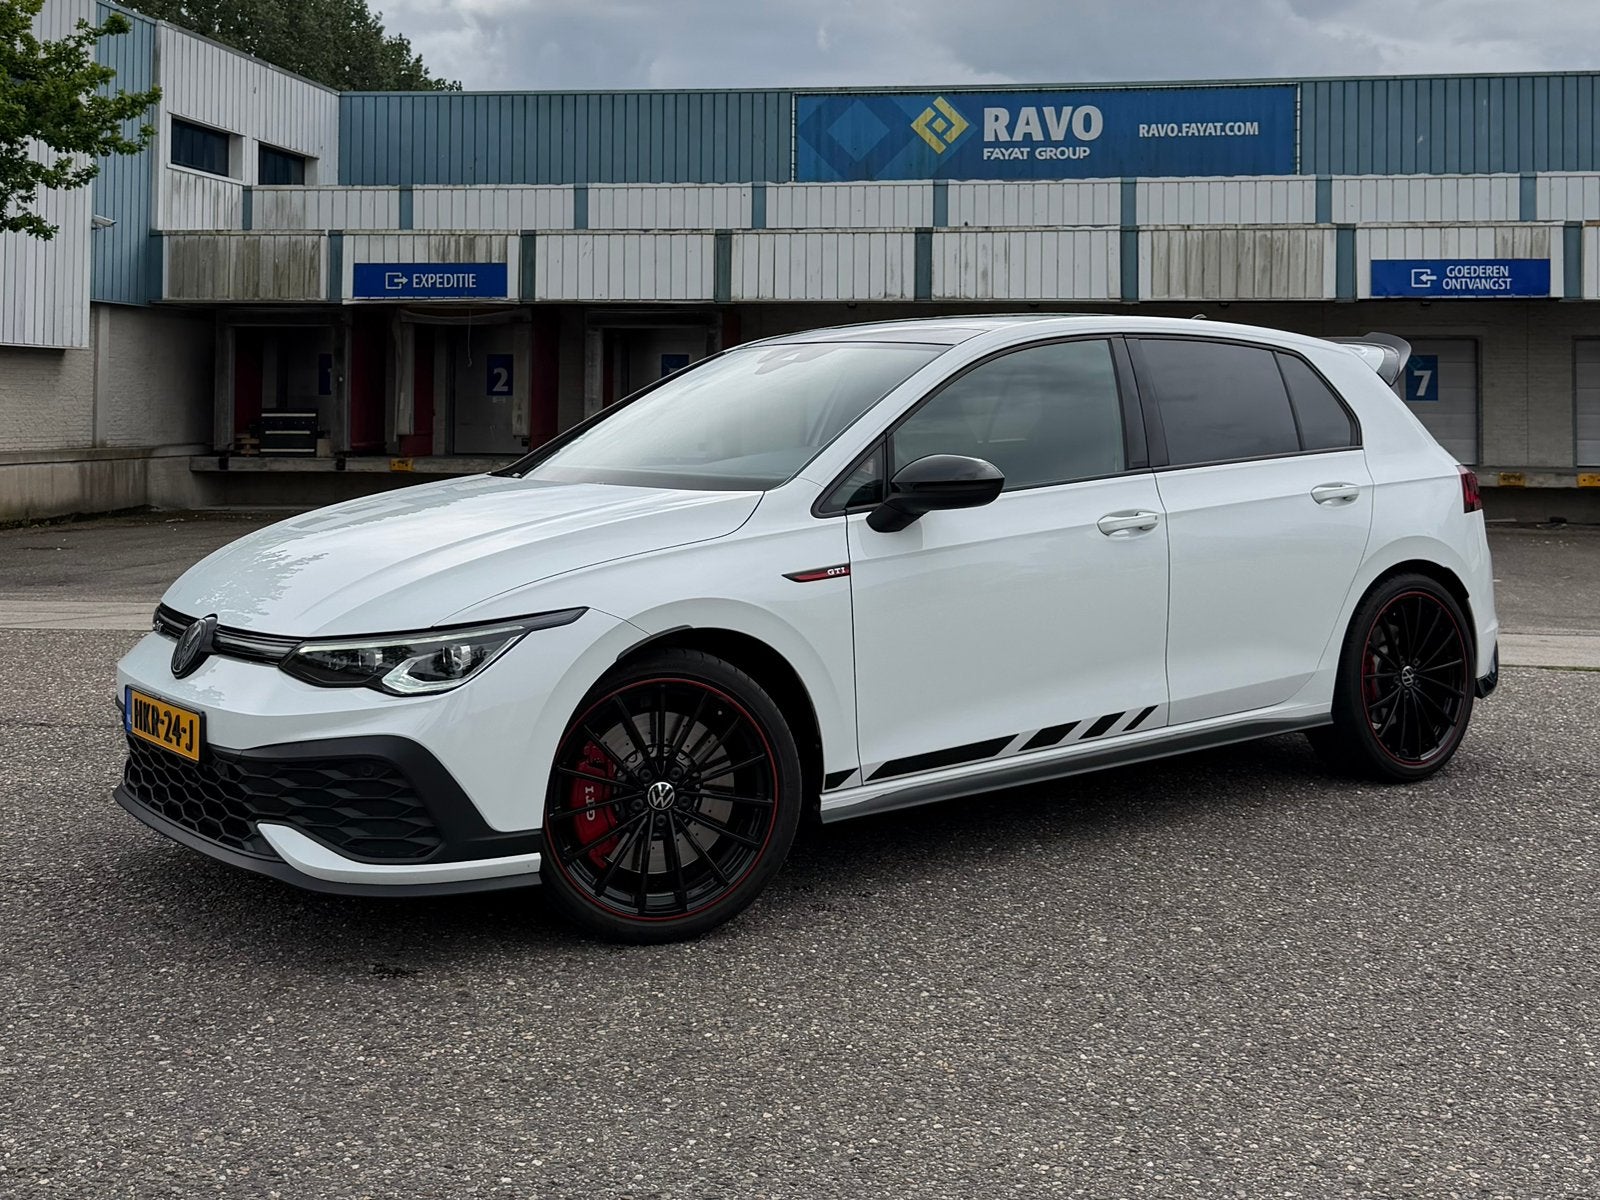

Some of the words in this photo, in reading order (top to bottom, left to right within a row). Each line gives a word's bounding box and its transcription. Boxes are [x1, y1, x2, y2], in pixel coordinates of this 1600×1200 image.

[983, 105, 1104, 141] RAVO
[1138, 121, 1259, 138] RAVO.FAYAT.COM
[983, 147, 1029, 160] FAYAT
[1034, 147, 1091, 160] GROUP
[1446, 264, 1509, 278] GOEDEREN
[412, 272, 477, 289] EXPEDITIE
[1441, 277, 1512, 291] ONTVANGST
[492, 367, 508, 392] 2
[1413, 370, 1433, 396] 7
[827, 567, 846, 577] GTI
[134, 698, 193, 752] HKR-24-J
[584, 785, 596, 821] GTI
